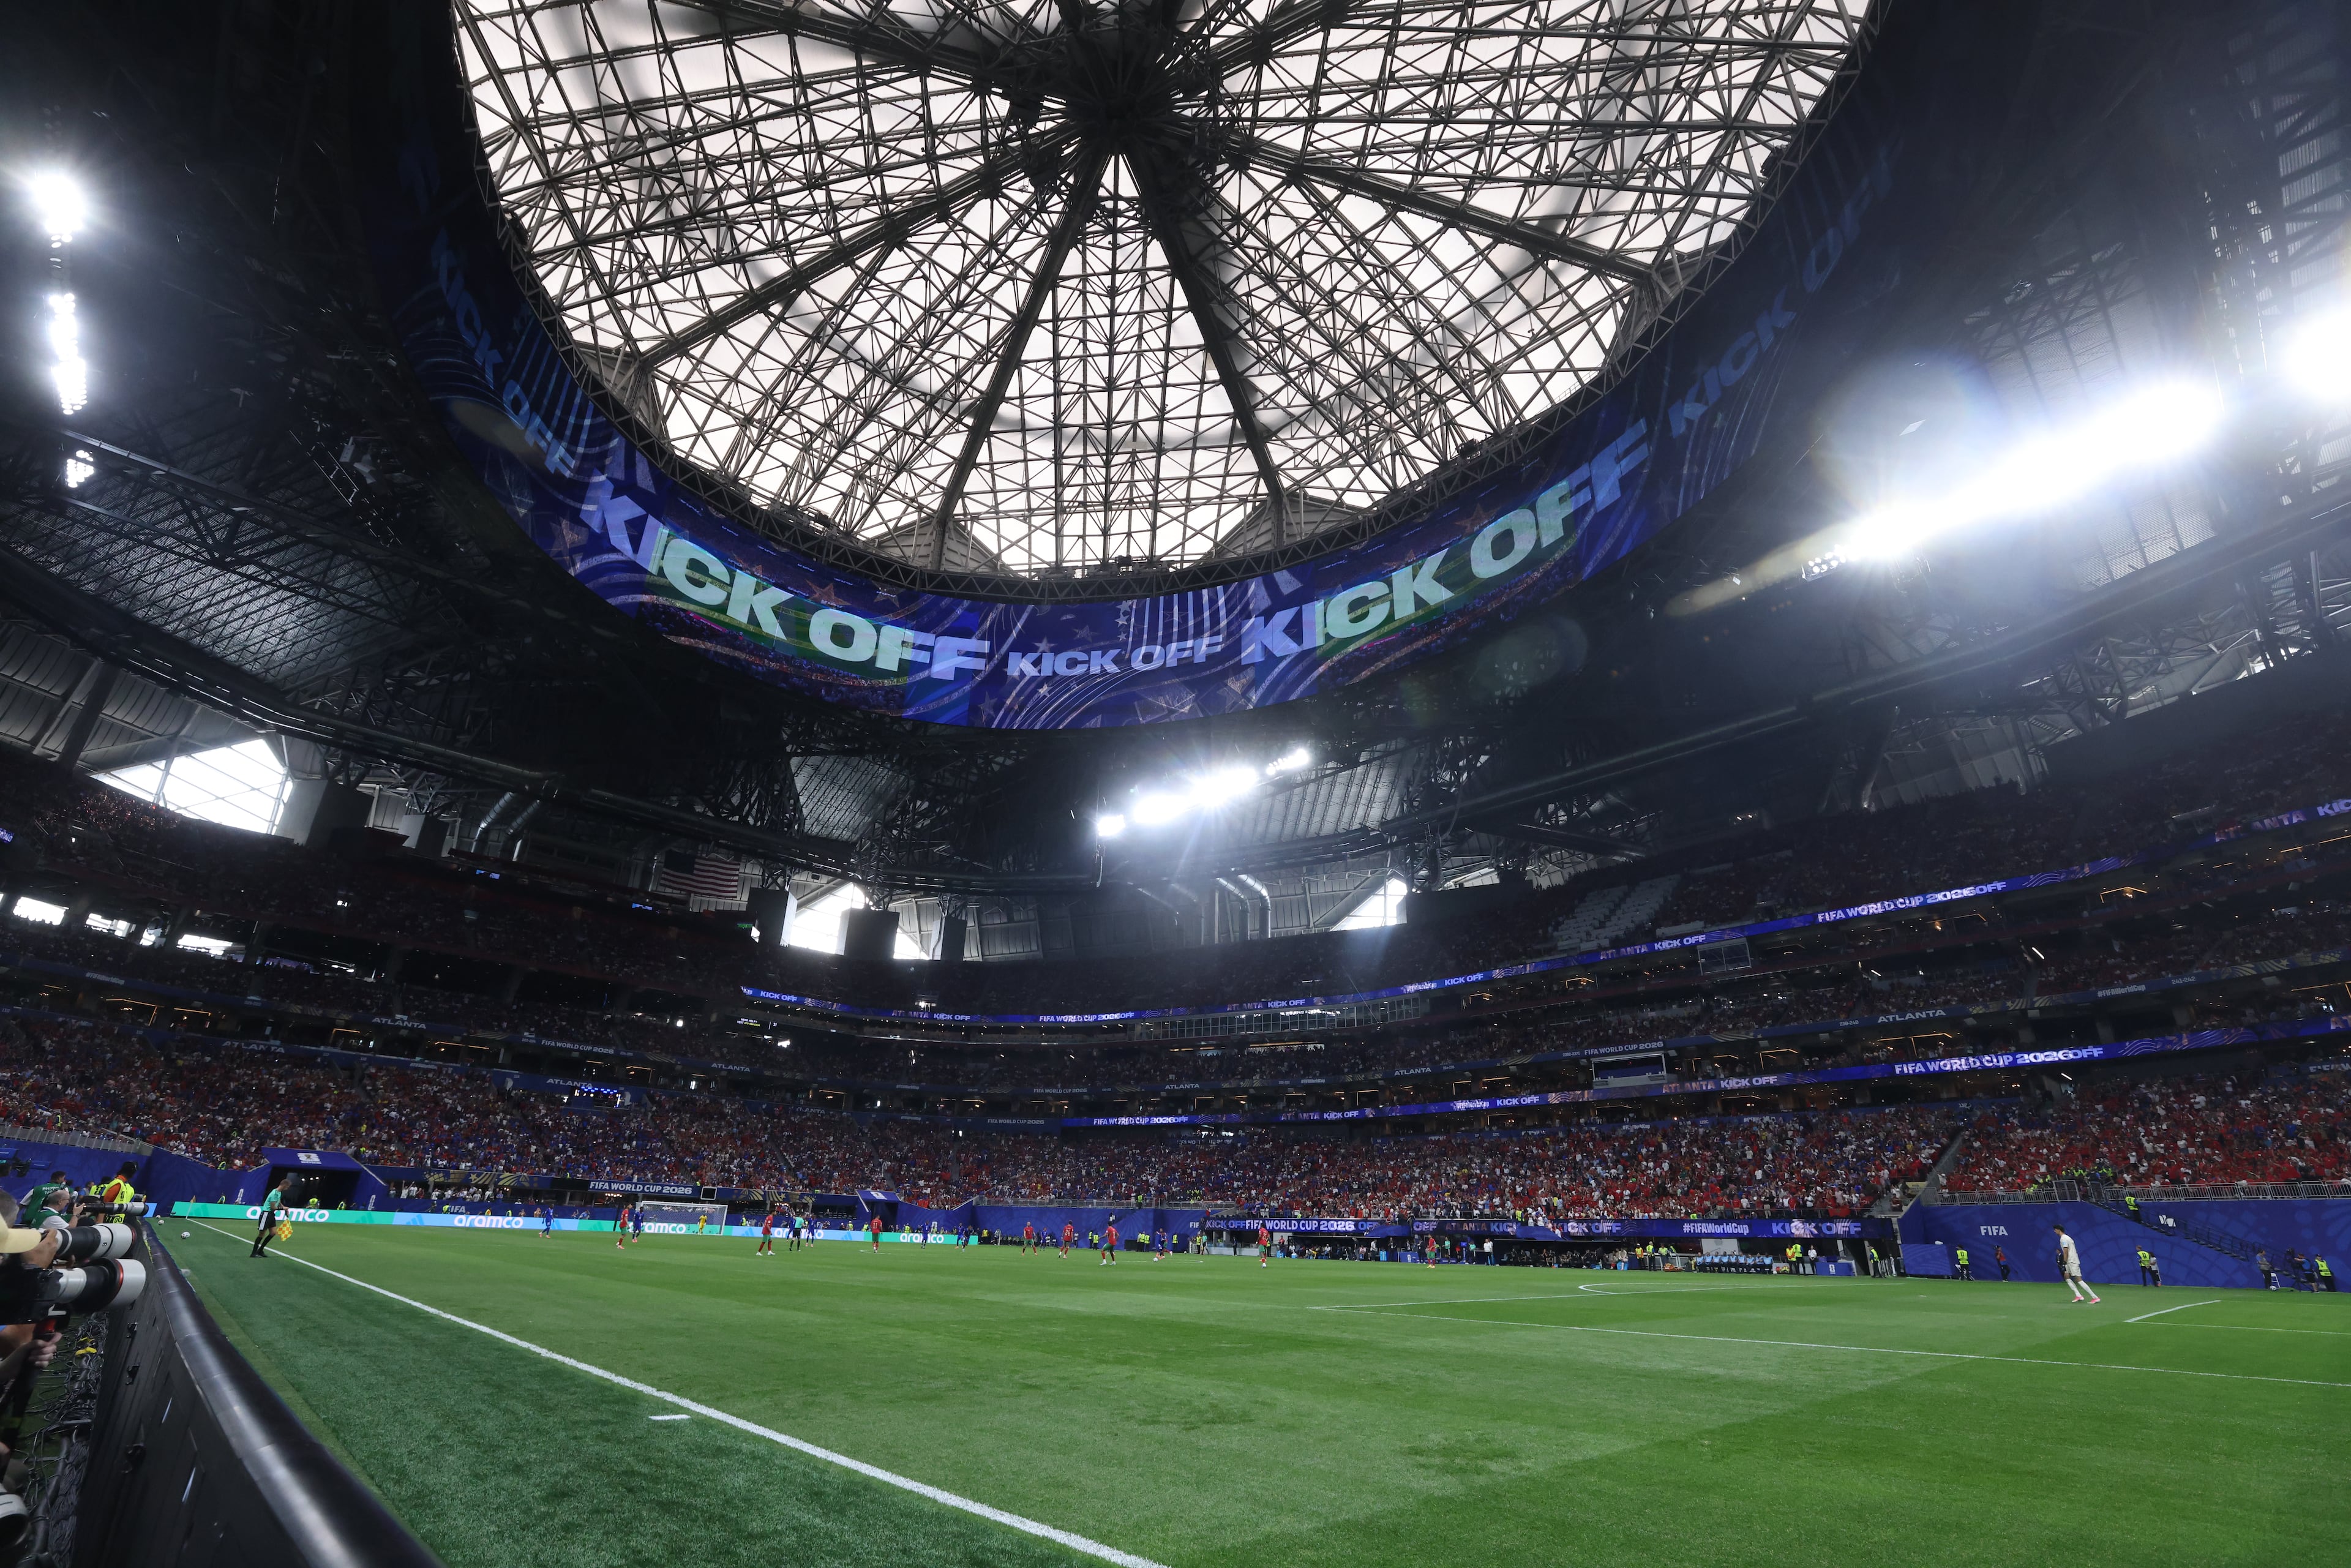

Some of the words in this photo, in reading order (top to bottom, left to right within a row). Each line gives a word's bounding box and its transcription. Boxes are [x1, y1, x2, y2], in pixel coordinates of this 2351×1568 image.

[430, 227, 506, 389] KICK
[503, 380, 580, 478] OFF
[1669, 284, 1797, 438] KICK
[1241, 548, 1455, 666] KICK
[1470, 418, 1650, 579] OFF
[580, 469, 794, 639] KICK
[809, 607, 991, 681] OFF
[1007, 649, 1122, 677] KICK
[1130, 636, 1223, 670] OFF
[2215, 810, 2307, 842] ATANTA
[1818, 911, 1846, 923] FIFA
[1846, 900, 1894, 918] WORLD
[1895, 895, 1924, 910] CUP
[1600, 944, 1649, 961] ATLANTA
[1654, 938, 1681, 951] KICK
[1682, 934, 1706, 946] OFF
[1444, 977, 1465, 986] KICK
[1466, 973, 1484, 983] OFF
[2098, 985, 2146, 998] #FIFAWorldCup
[2172, 975, 2196, 985] 241-242
[760, 991, 780, 1000] KICK
[372, 1017, 427, 1029] ATLANTA
[1056, 1015, 1082, 1023] WORLD
[1083, 1013, 1097, 1022] CUP
[1877, 1009, 1946, 1024] ATLANTA
[222, 1041, 285, 1054] ATLANTA
[1639, 1041, 1664, 1049] 2026
[711, 1063, 751, 1072] ATLANTA
[1895, 1062, 1927, 1075] FIFA
[1927, 1055, 1981, 1072] WORLD
[1982, 1053, 2014, 1069] CUP
[1394, 1067, 1431, 1076] ATLANTA
[546, 1078, 593, 1089] ATLANTA
[1662, 1079, 1715, 1093] ATLANTA
[1720, 1078, 1750, 1089] KICK
[1752, 1075, 1778, 1086] OFF
[1497, 1097, 1520, 1106] KICK
[1520, 1095, 1540, 1105] OFF
[1108, 1117, 1135, 1126] WORLD
[1135, 1117, 1149, 1125] CUP
[1323, 1111, 1343, 1120] KICK
[590, 1181, 610, 1190] FIFA
[611, 1182, 643, 1192] WORLD
[643, 1184, 662, 1193] CUP
[662, 1185, 692, 1195] 2026
[246, 1206, 329, 1222] aamco
[454, 1215, 523, 1229] aramco
[629, 1221, 686, 1234] amco
[1205, 1220, 1227, 1229] KICK
[1228, 1220, 1247, 1229] OFF
[1265, 1220, 1298, 1230] WORLD
[1299, 1220, 1318, 1230] CUP
[1319, 1220, 1355, 1231] 2026
[1413, 1221, 1437, 1231] OFF
[1445, 1221, 1488, 1231] ATLANTA
[1592, 1221, 1622, 1234] OFF
[1772, 1221, 1818, 1235] KICK
[1821, 1221, 1862, 1234] OFF
[774, 1228, 824, 1239] armo
[1683, 1223, 1749, 1236] #FIFAWorldCup
[1980, 1226, 2009, 1236] FIFA
[899, 1232, 944, 1244] araco
